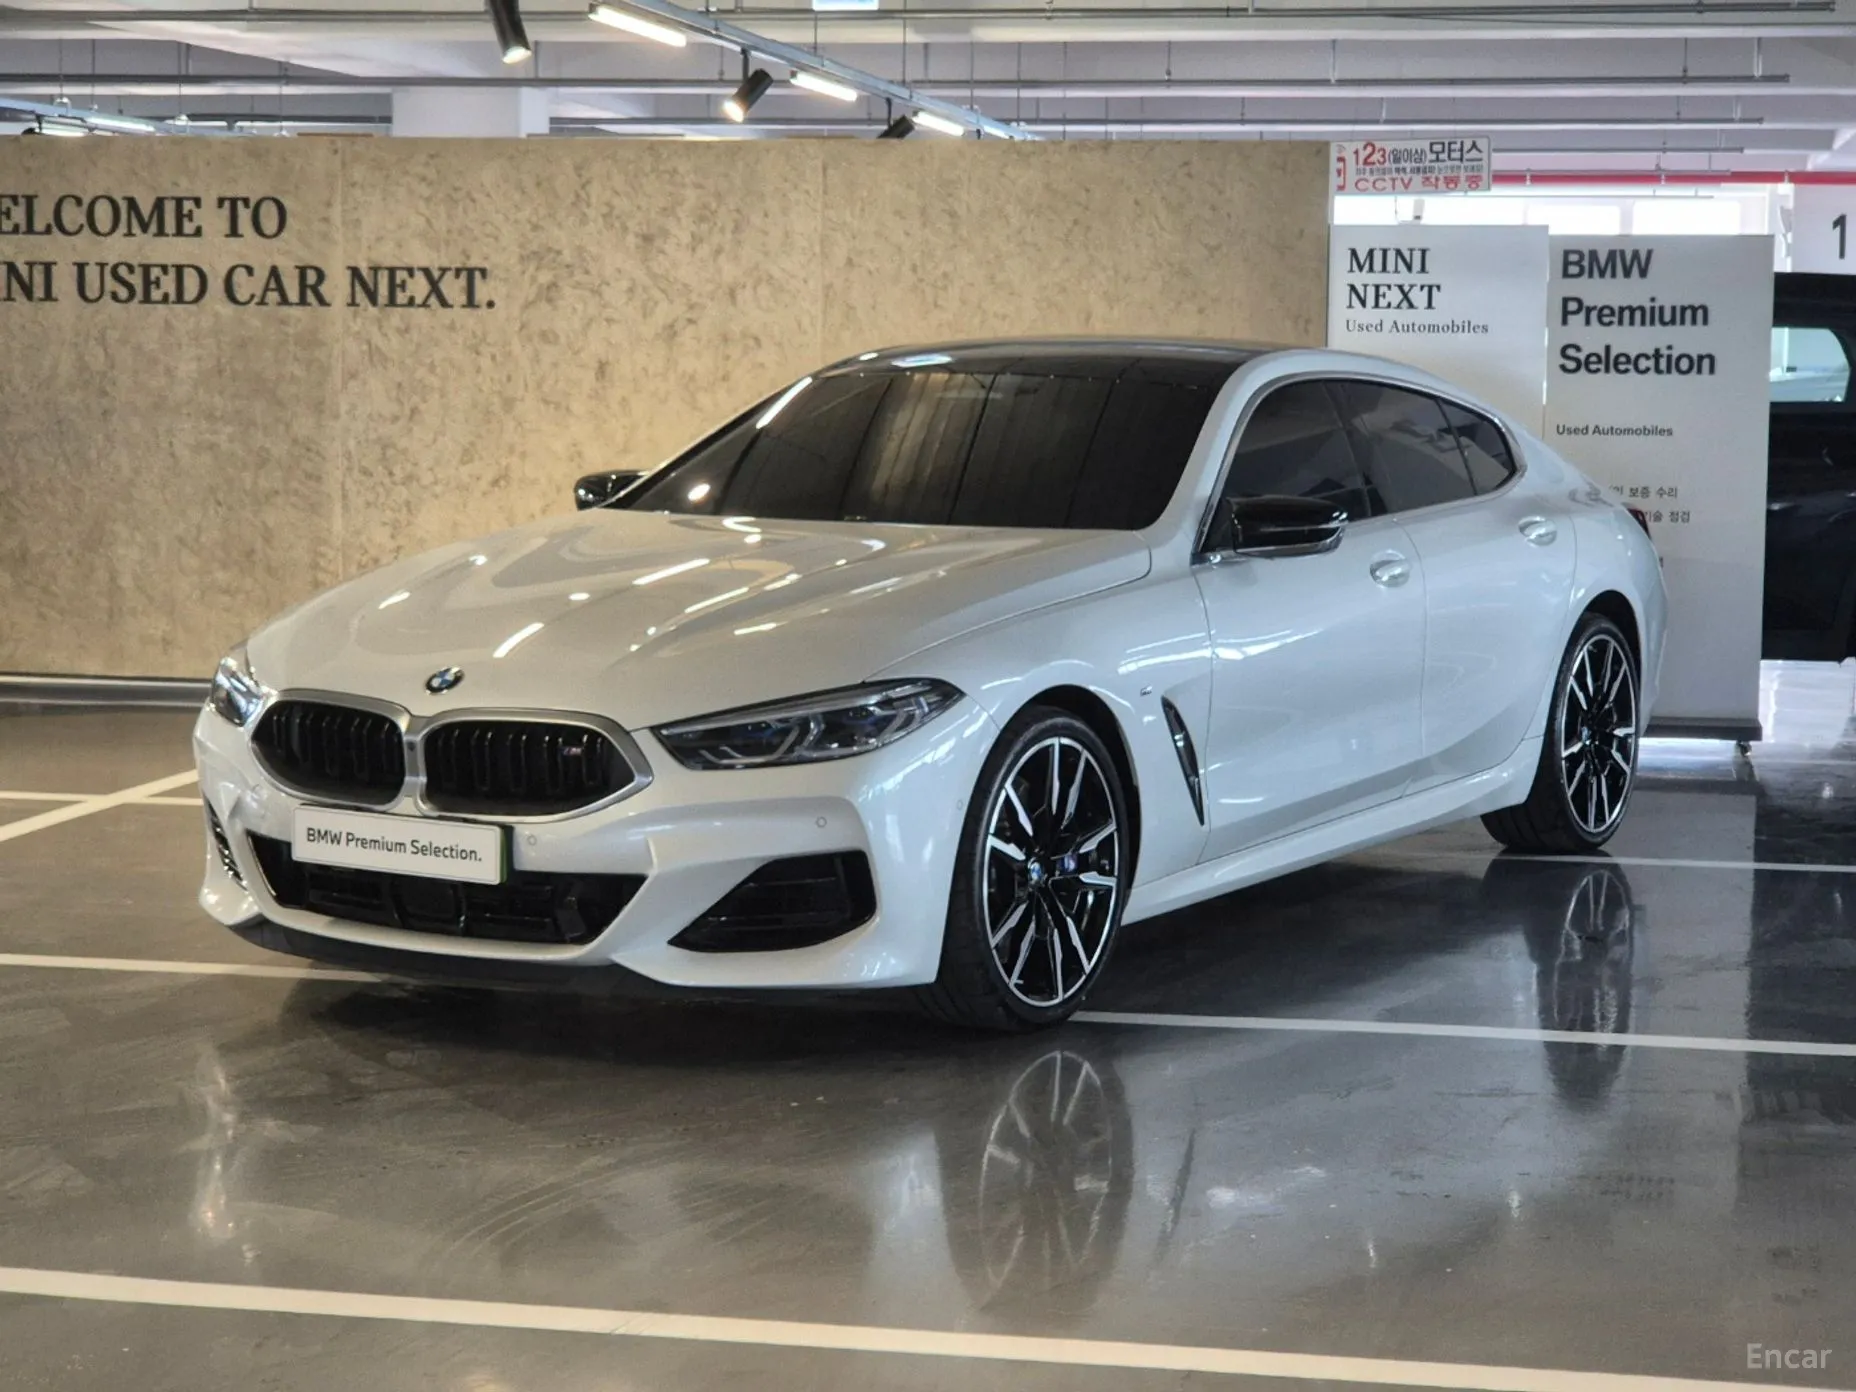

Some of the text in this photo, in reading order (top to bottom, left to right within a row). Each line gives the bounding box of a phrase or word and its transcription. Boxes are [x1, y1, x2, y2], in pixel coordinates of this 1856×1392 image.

[1354, 177, 1413, 192] CCTV
[217, 196, 288, 239] TO
[1832, 213, 1847, 260] 1
[1347, 247, 1430, 274] MINI
[1561, 248, 1654, 279] BMW
[0, 260, 496, 309] NI USED CAR NEXT.
[1346, 283, 1441, 310] NEXT
[1345, 319, 1489, 334] Used Automobiles
[1560, 296, 1709, 327] Premium
[1558, 343, 1716, 375] Selection
[1556, 424, 1673, 437] Used Automobiles
[1656, 486, 1678, 499] 수리
[306, 827, 483, 862] BMW Premium Selection.
